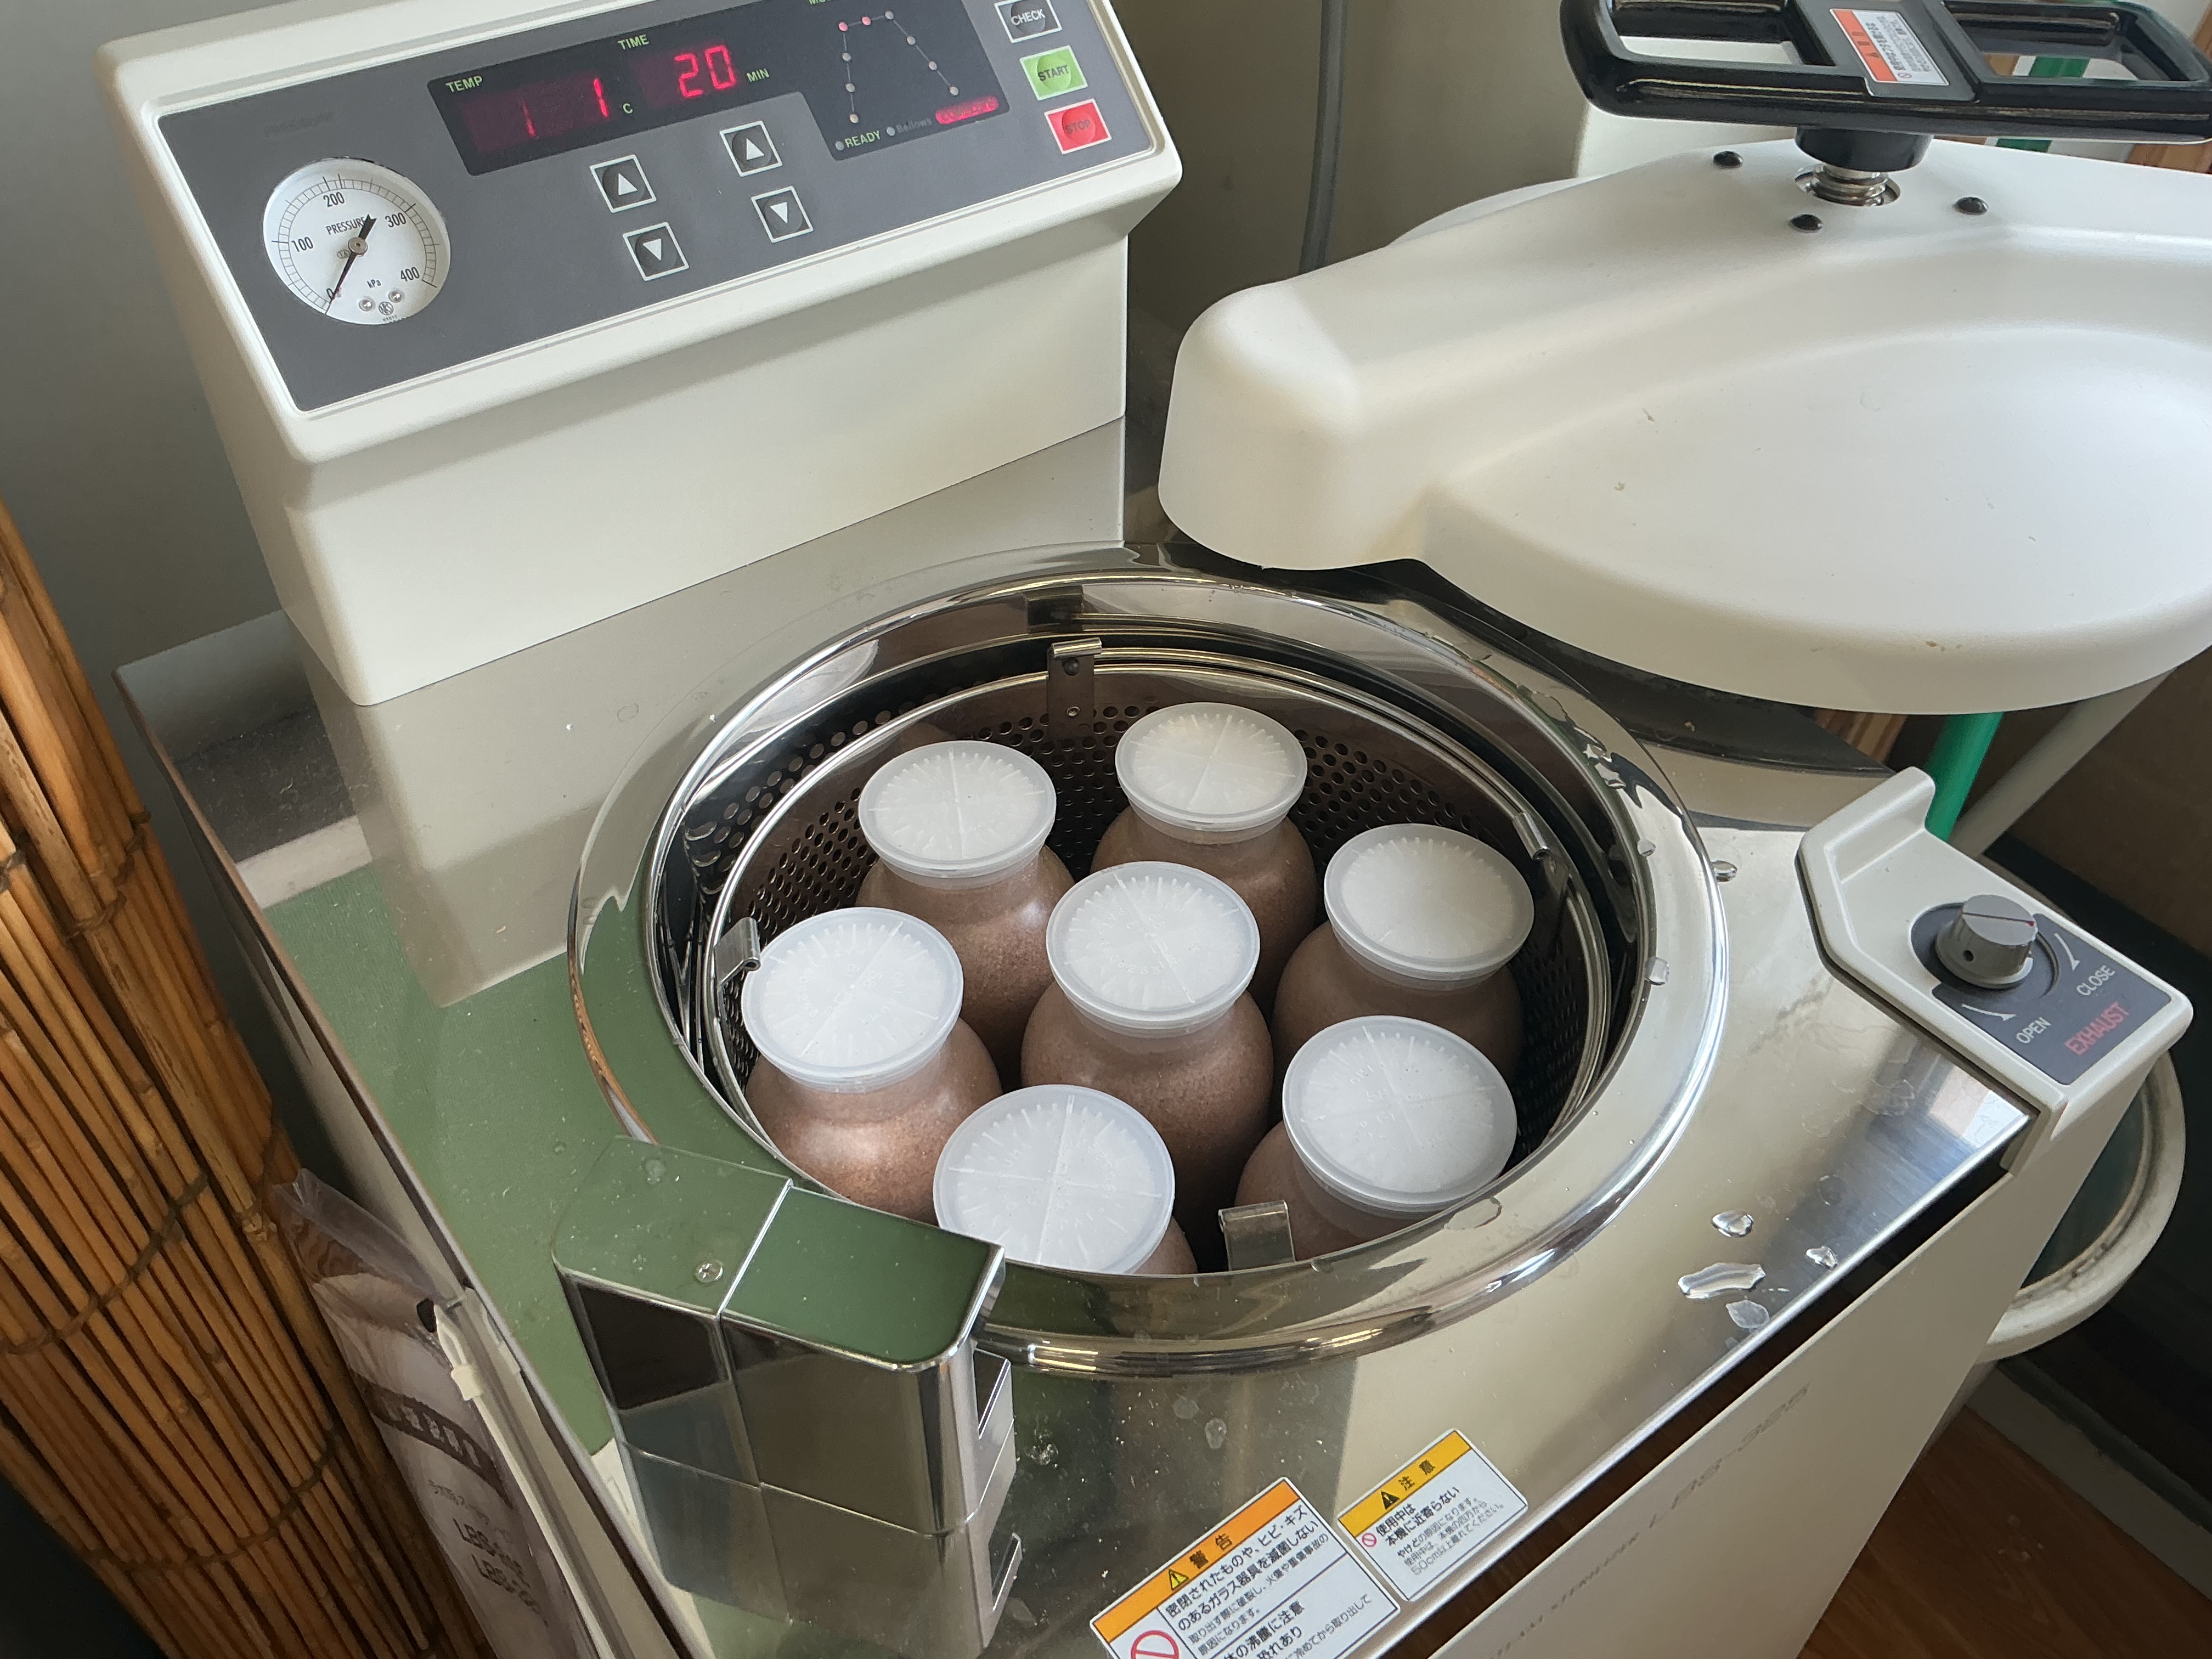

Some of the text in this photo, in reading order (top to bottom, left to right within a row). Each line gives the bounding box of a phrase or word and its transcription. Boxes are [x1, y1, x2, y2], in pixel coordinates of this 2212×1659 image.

[1011, 9, 1046, 26] CHECK
[618, 34, 650, 50] TIME
[674, 44, 736, 98] 20
[746, 68, 770, 82] MIN
[1037, 65, 1069, 82] START
[445, 75, 483, 93] TEMP
[1065, 119, 1091, 134] STOP
[845, 130, 881, 149] READY
[323, 192, 345, 208] 200
[385, 212, 407, 228] 300
[291, 236, 314, 252] 100
[399, 267, 420, 282] 400
[366, 279, 382, 289] kPa
[2076, 965, 2116, 996] CLOSE
[2016, 1017, 2052, 1043] OPEN
[2064, 1001, 2130, 1056] EXHAUST
[1375, 1503, 1417, 1537] 使用中は
[1385, 1486, 1461, 1546] 本機に近寄らない
[1178, 1520, 1319, 1630] のあるガラス器具を滅菌しない
